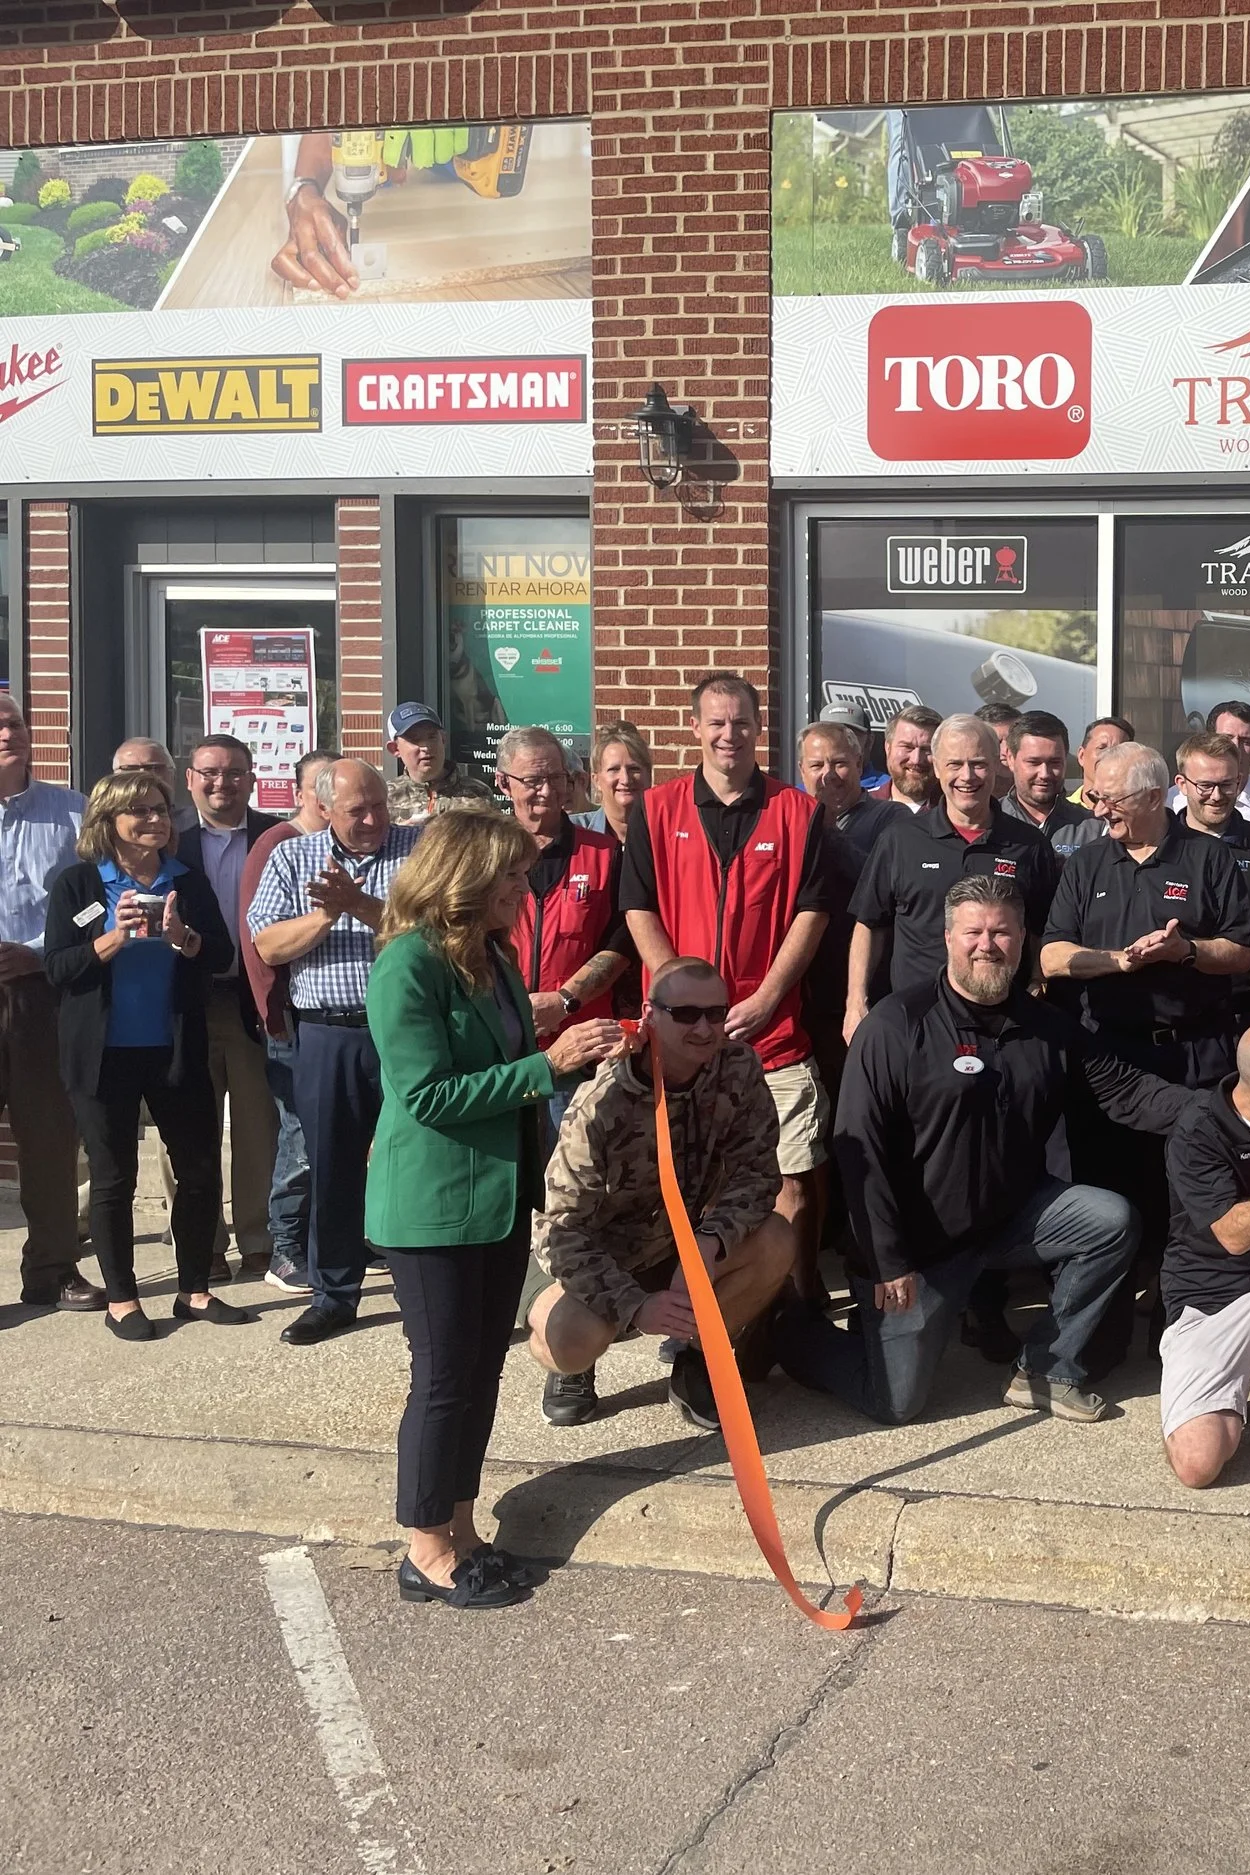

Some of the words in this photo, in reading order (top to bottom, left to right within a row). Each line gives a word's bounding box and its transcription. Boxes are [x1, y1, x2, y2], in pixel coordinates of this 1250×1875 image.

[884, 352, 1076, 412] TORO
[358, 371, 570, 411] CRAFTSMAN
[448, 552, 518, 577] RENT
[896, 538, 991, 585] weber
[455, 582, 521, 596] RENTAR
[526, 582, 587, 596] AHORA
[1221, 588, 1248, 596] WOOD
[480, 609, 573, 619] PROFESSIONAL
[473, 621, 520, 631] CARPET
[523, 621, 580, 631] CLEANER
[211, 634, 230, 643] ACE
[555, 724, 573, 732] 6:00
[261, 780, 288, 789] FREE
[754, 842, 775, 851] ACE
[569, 873, 590, 882] ACE
[1163, 886, 1187, 897] ACE
